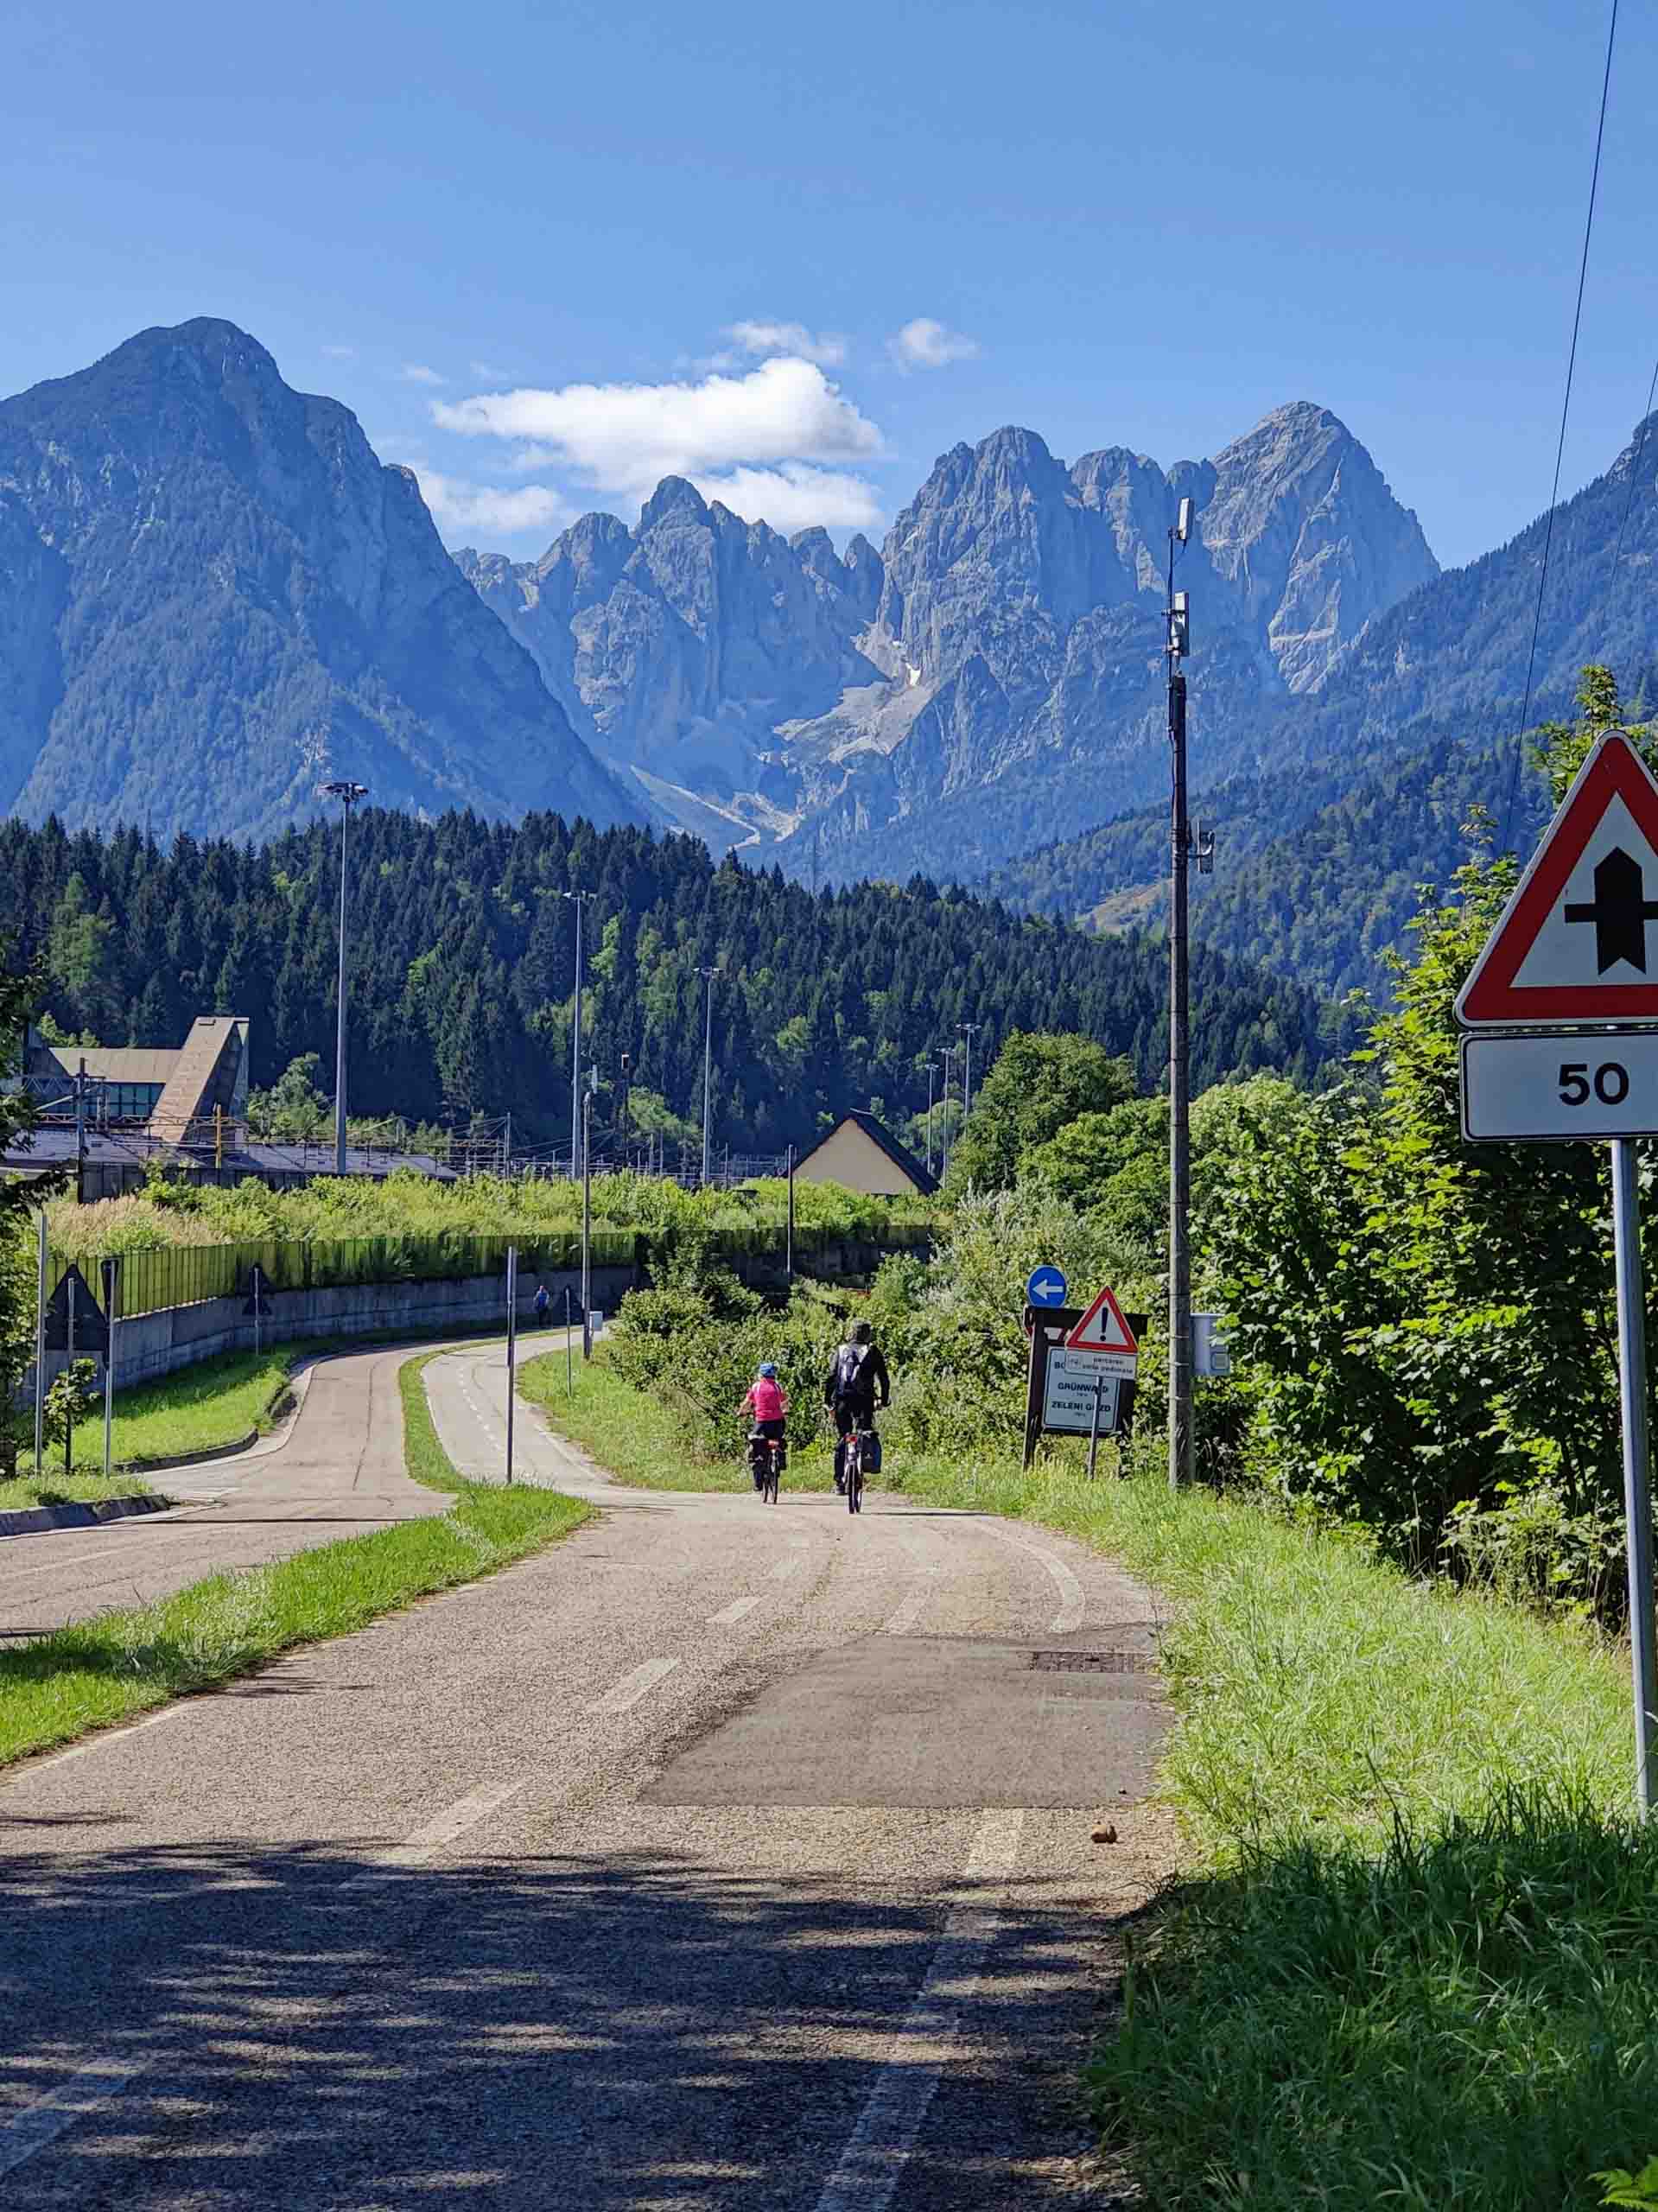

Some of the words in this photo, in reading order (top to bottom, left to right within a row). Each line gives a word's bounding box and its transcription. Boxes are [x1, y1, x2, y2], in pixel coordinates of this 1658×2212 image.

[1559, 1063, 1629, 1106] 50
[1058, 1382, 1109, 1393] GRÜNWAD
[1085, 1403, 1111, 1412] GZD
